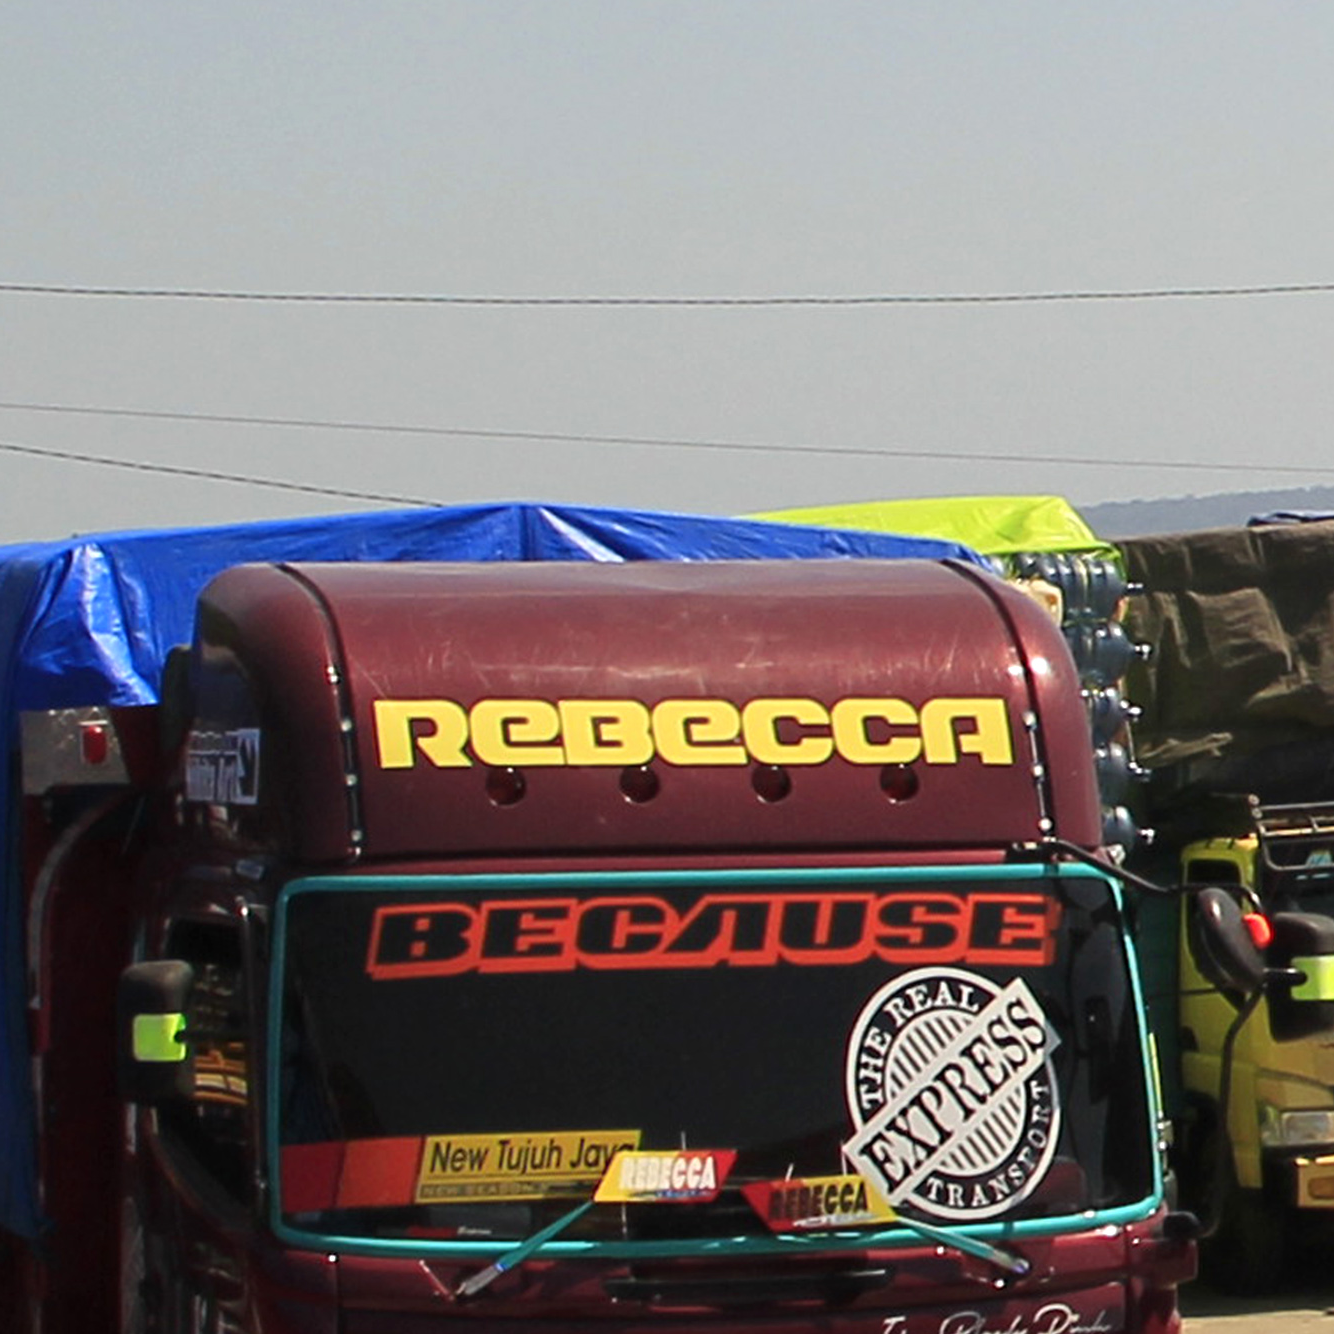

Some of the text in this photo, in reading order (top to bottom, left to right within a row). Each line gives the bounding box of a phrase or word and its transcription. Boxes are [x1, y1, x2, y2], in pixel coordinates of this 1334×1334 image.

[366, 893, 1057, 979] BECAUSE
[858, 981, 980, 1110] THE REAL
[858, 997, 1047, 1195] EXPRESS
[428, 1141, 485, 1173] New
[496, 1138, 563, 1175] Tujuh
[619, 1155, 716, 1190] REBECCA
[926, 1080, 1052, 1207] TRANSPORT
[769, 1182, 868, 1219] REBECCA
